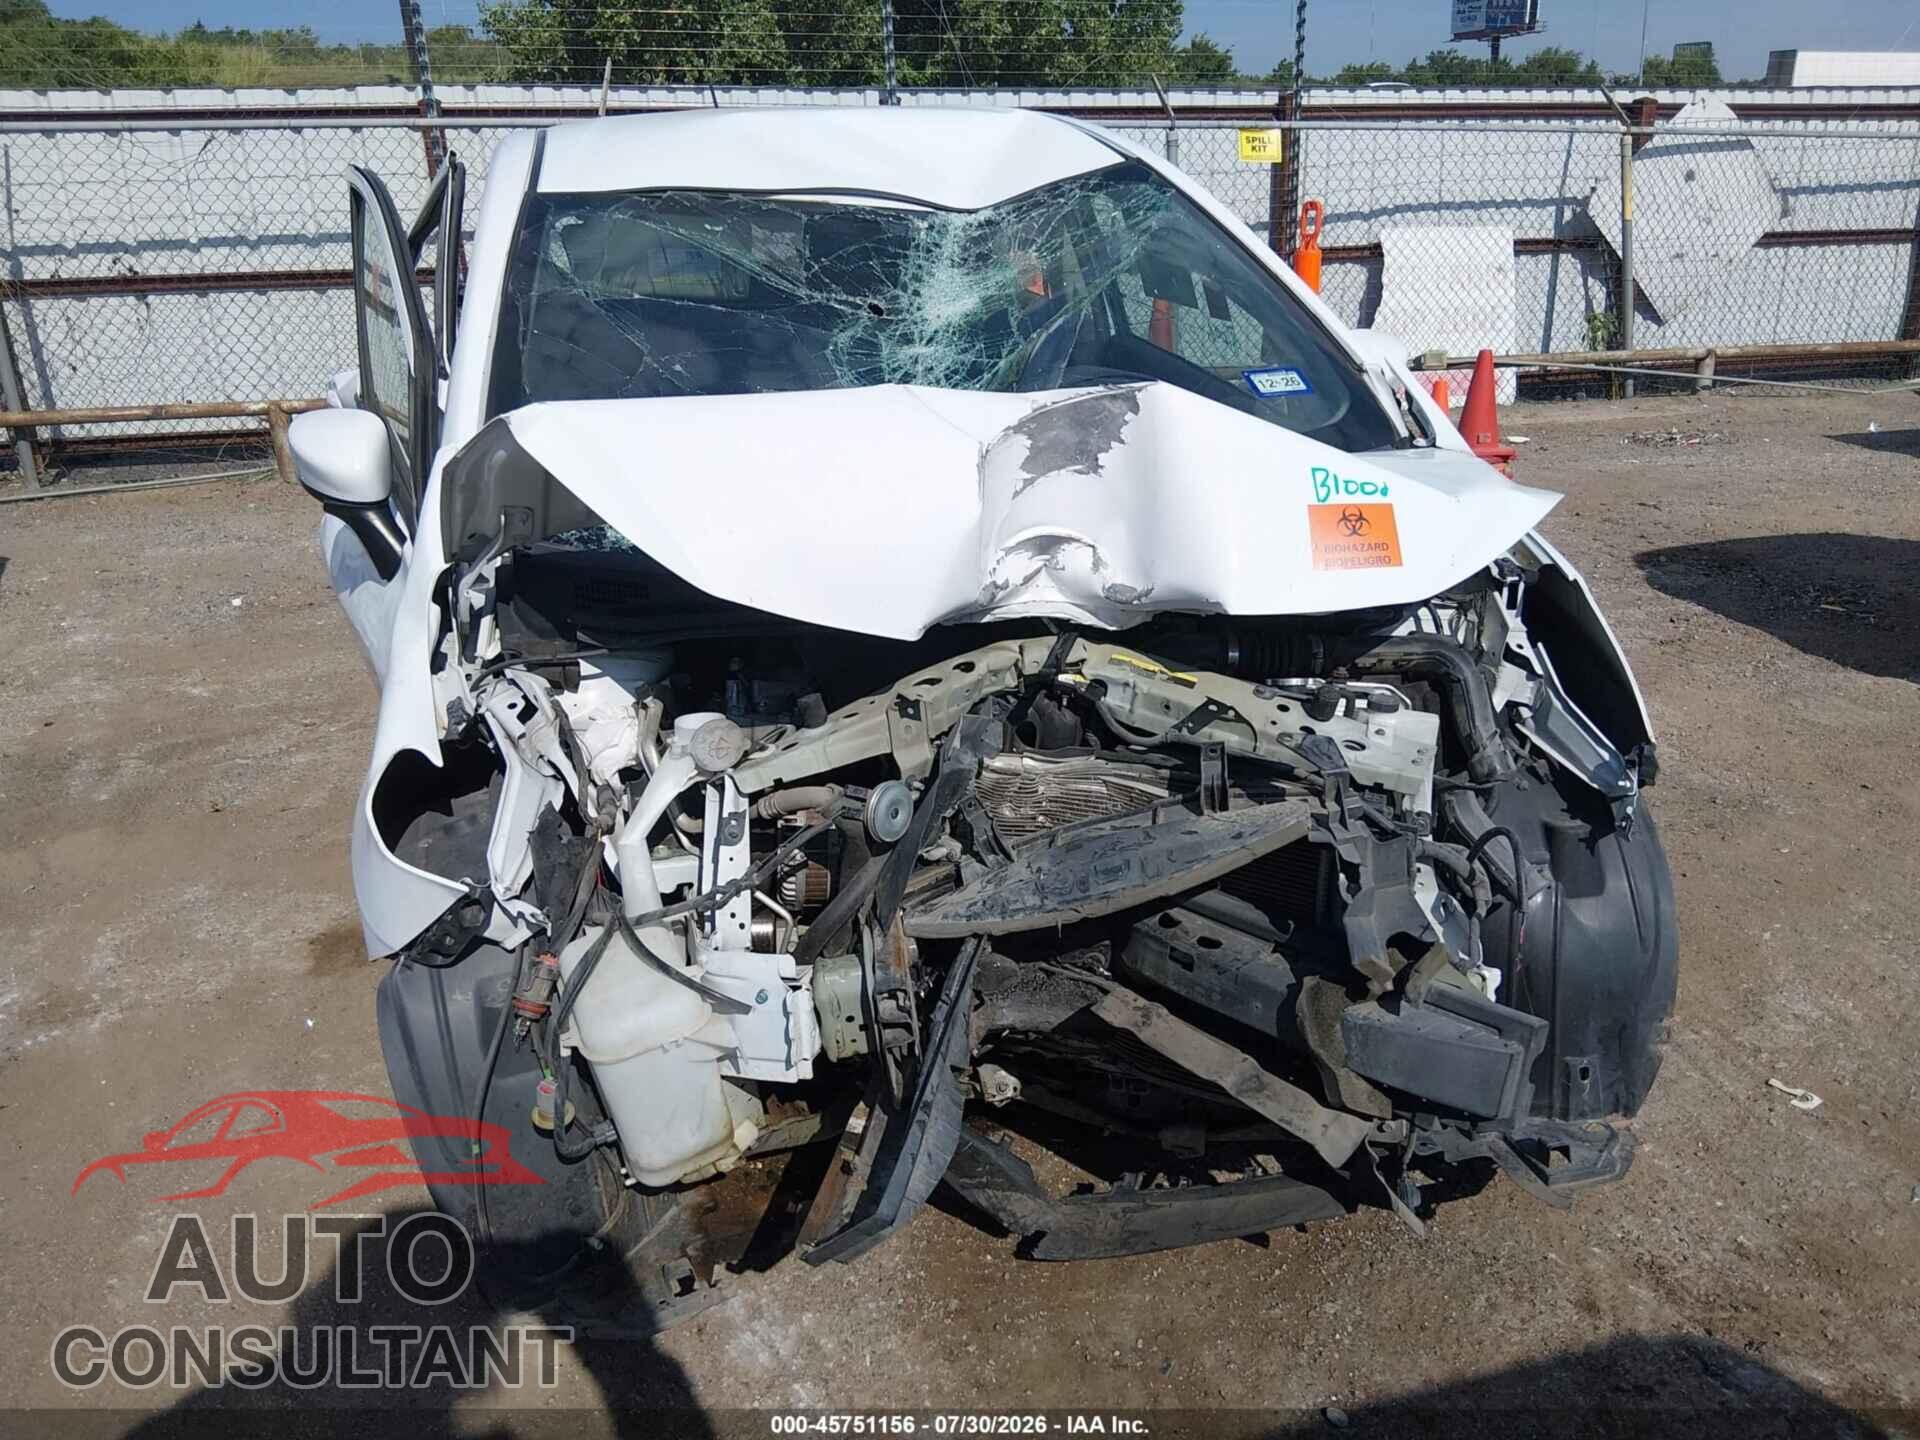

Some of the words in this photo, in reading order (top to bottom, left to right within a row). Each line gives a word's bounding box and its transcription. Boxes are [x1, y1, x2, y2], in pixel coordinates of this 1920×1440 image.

[1245, 135, 1272, 145] SPILL
[1251, 144, 1267, 153] KIT
[1324, 542, 1390, 553] BIOHAZARD
